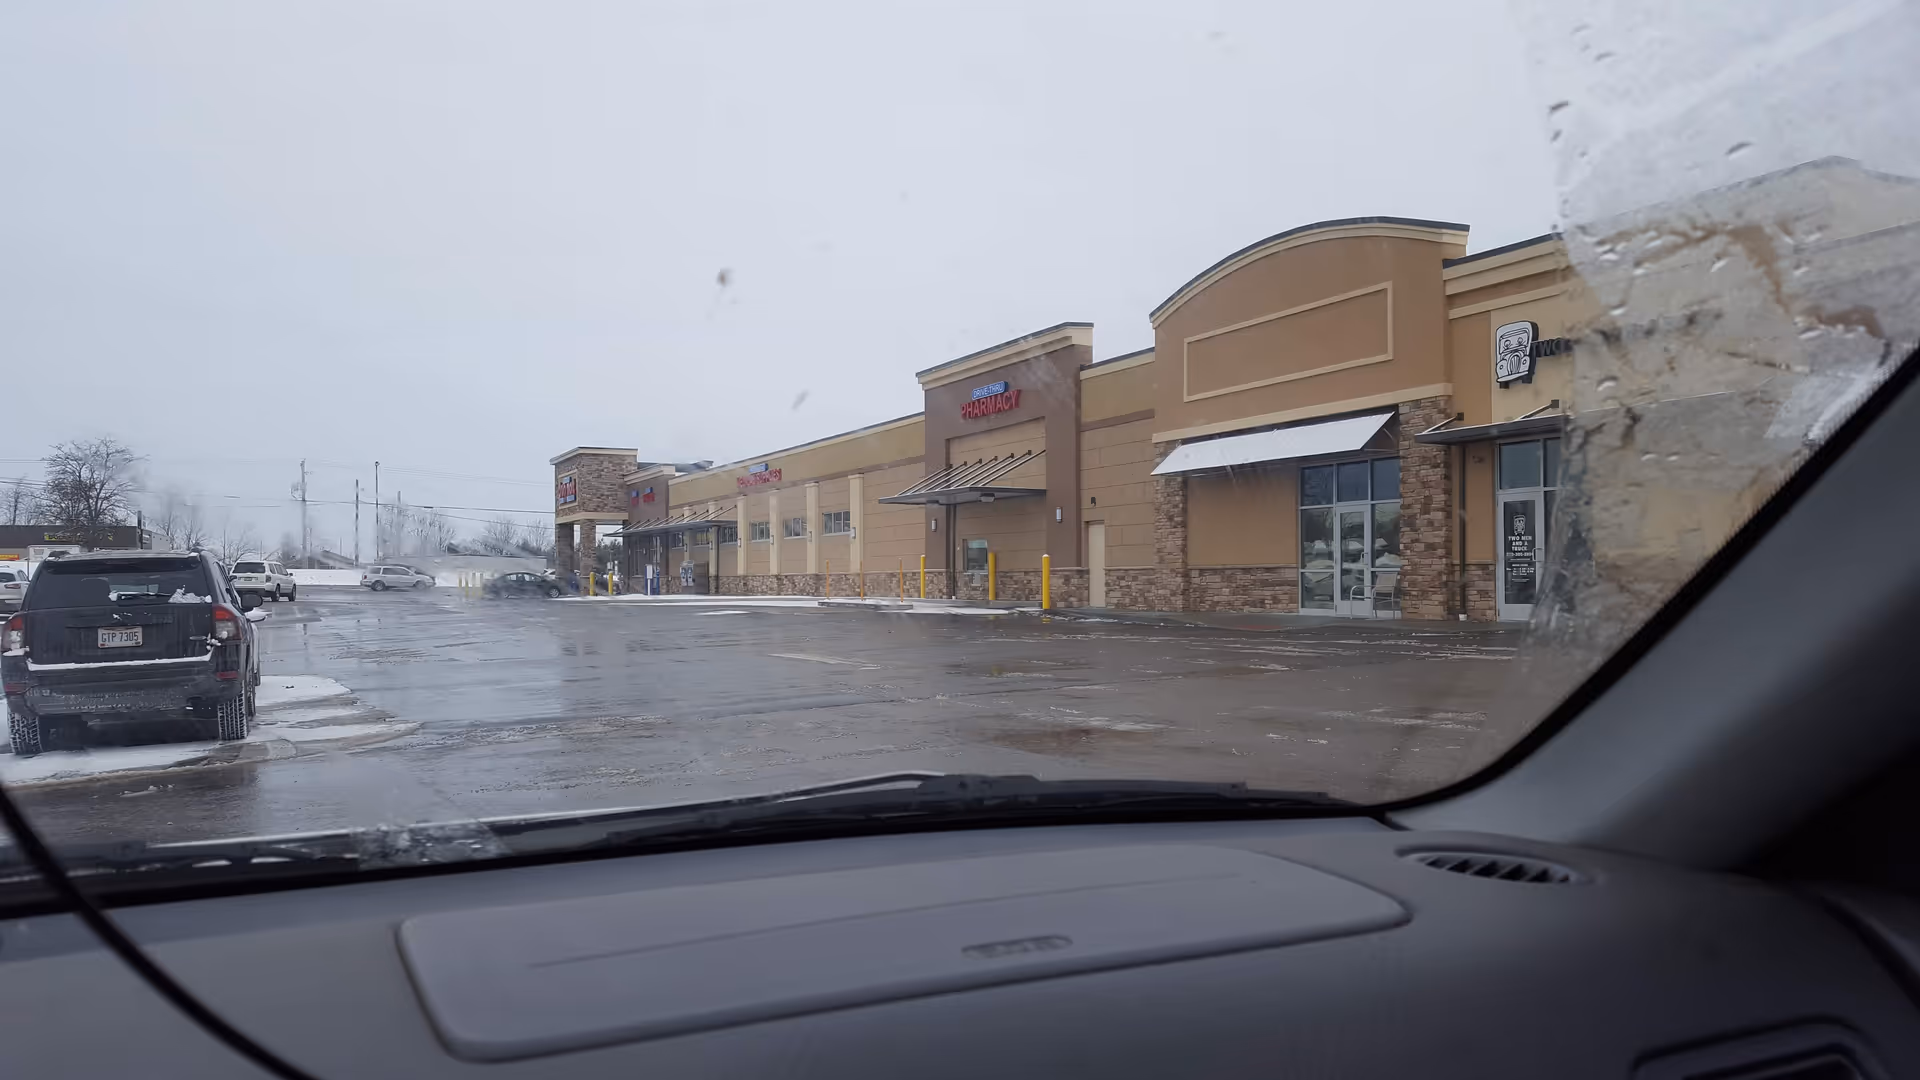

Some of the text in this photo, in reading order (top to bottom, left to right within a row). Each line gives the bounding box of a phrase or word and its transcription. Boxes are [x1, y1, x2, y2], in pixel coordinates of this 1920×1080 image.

[973, 383, 1004, 398] DRIVE-THRU
[961, 390, 1019, 419] PHARMACY
[101, 631, 139, 642] GTP 7305
